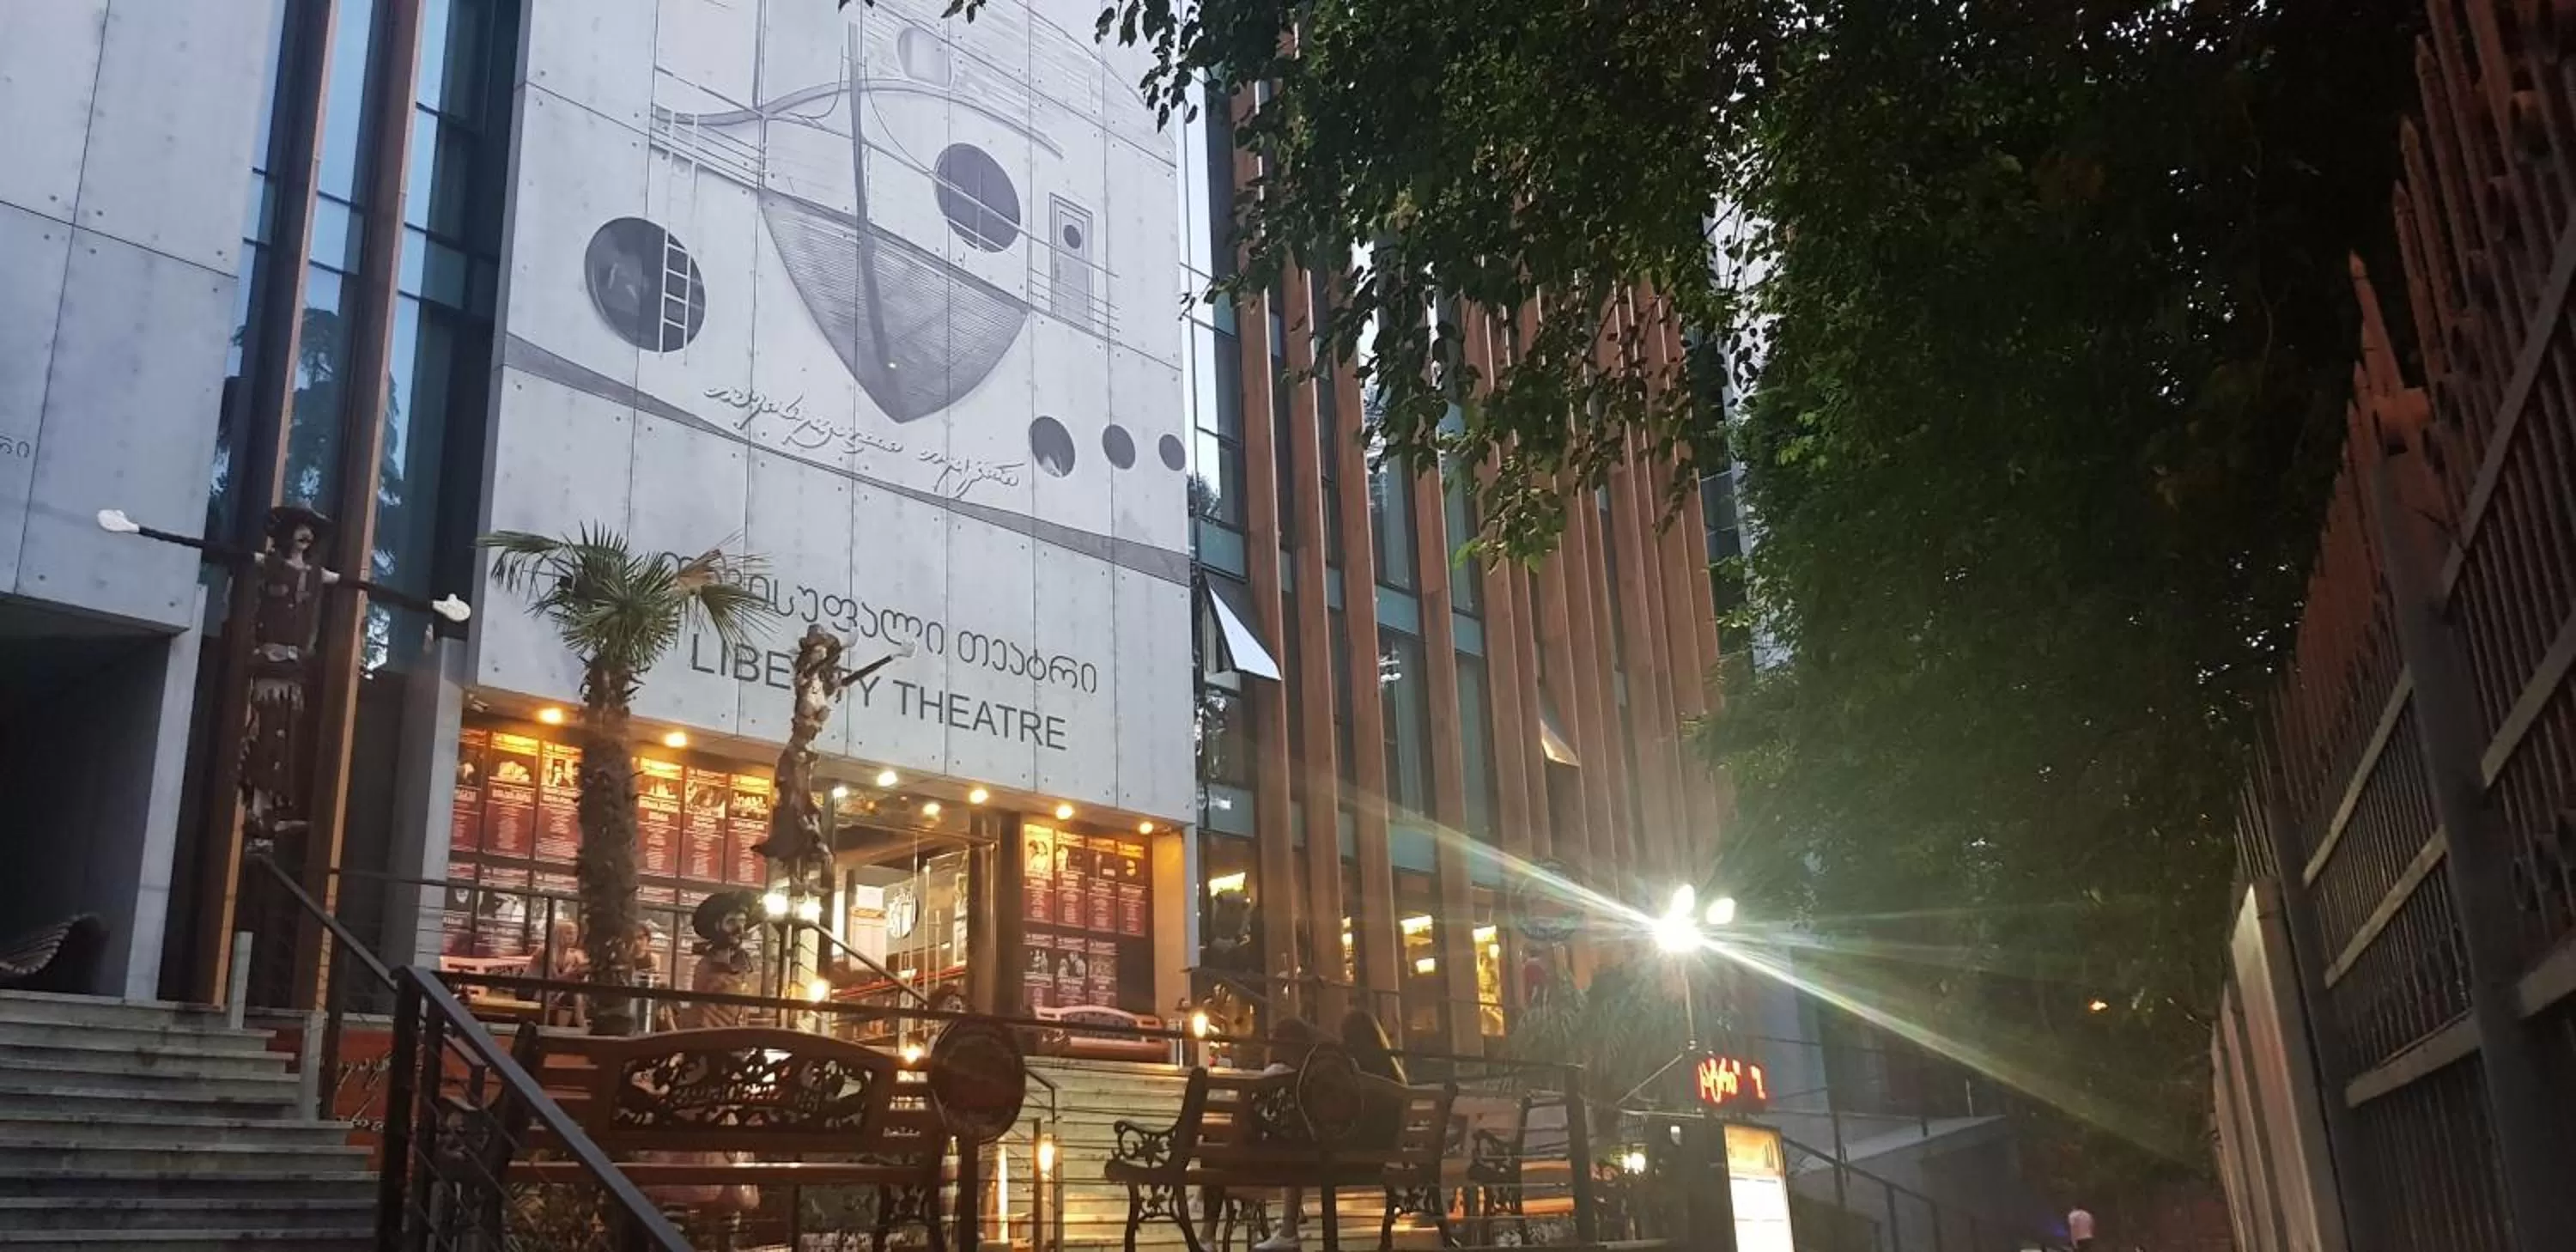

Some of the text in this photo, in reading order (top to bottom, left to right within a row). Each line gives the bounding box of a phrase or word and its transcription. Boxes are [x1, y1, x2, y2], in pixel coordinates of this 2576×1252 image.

[690, 634, 1066, 751] LIBEY THEATRE
[957, 630, 1097, 693] თეატრი
